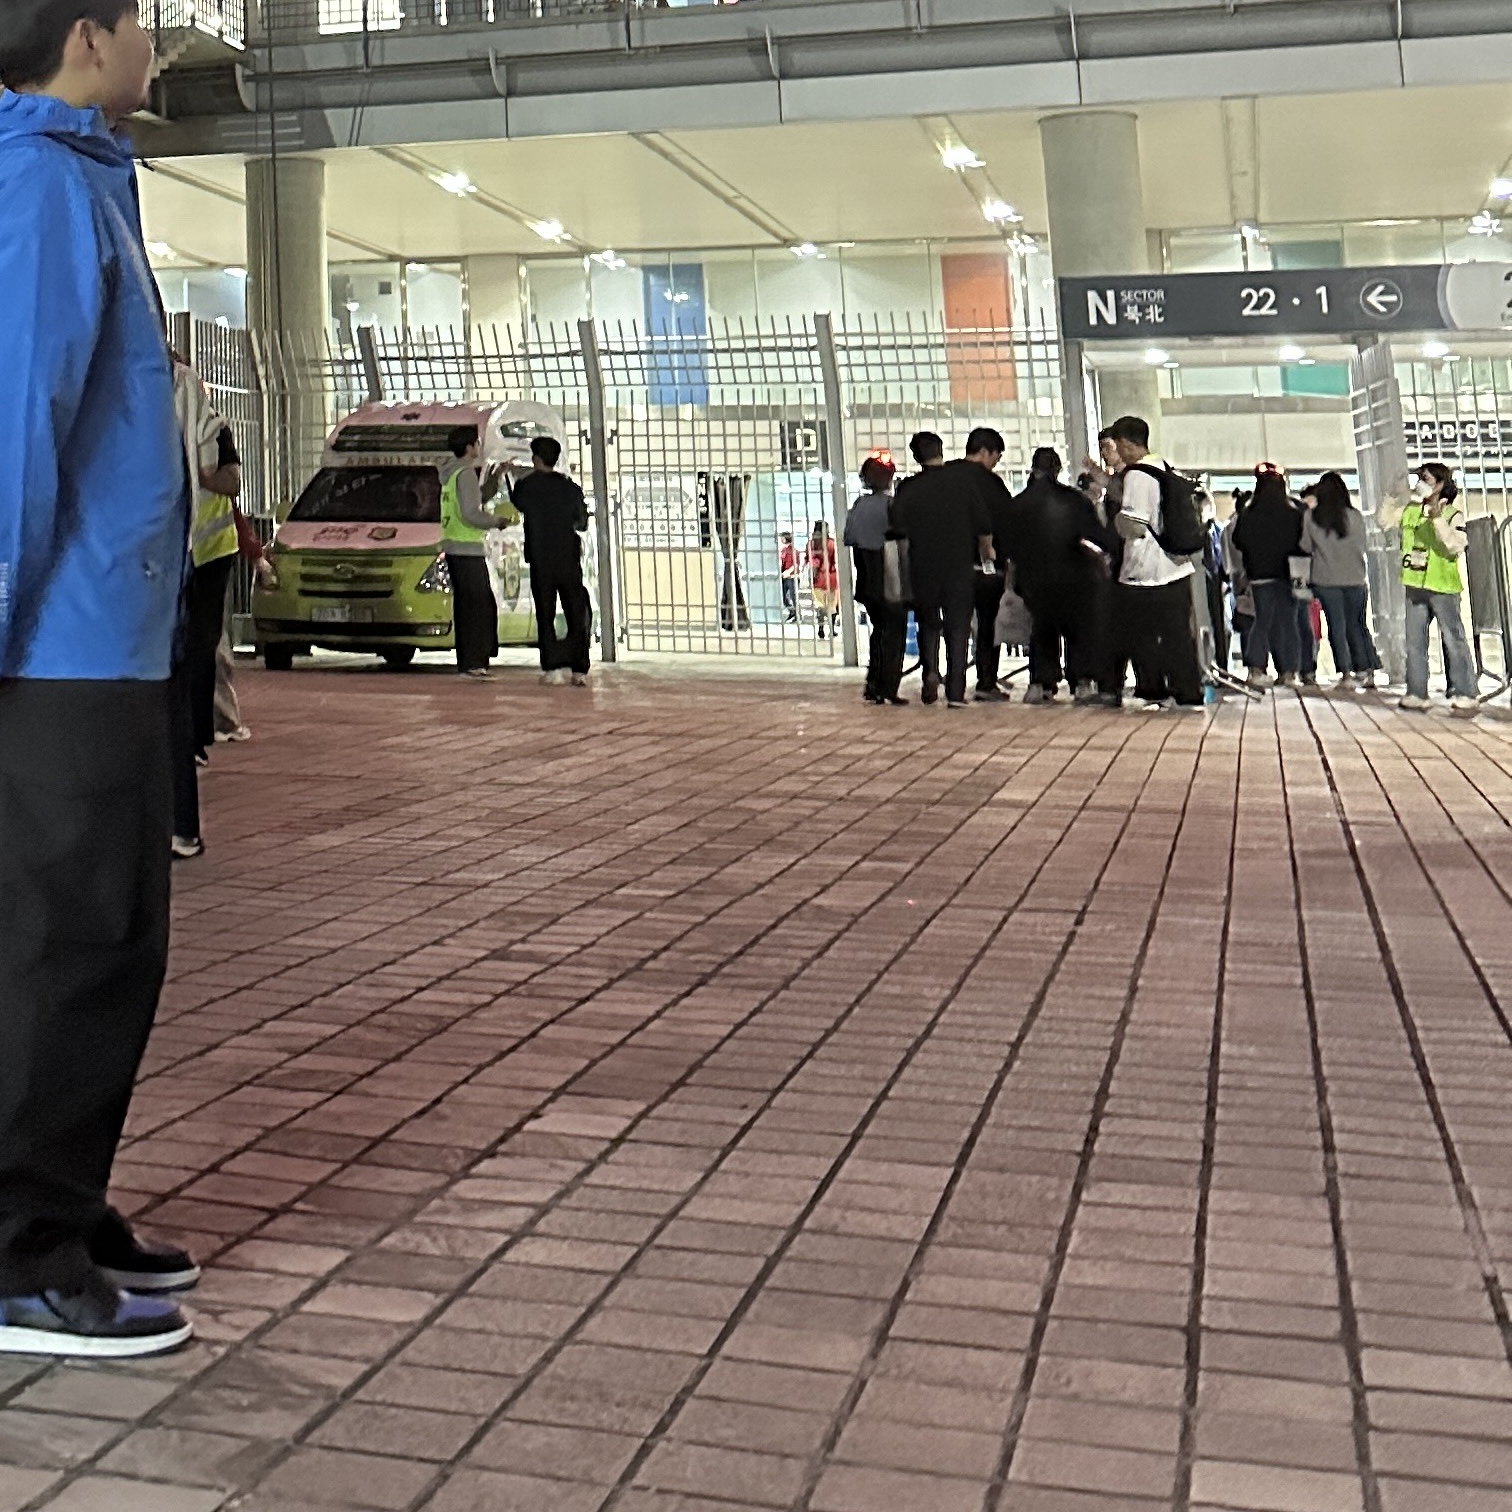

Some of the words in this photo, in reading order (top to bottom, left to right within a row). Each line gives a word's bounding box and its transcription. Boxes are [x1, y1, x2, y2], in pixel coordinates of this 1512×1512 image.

[1087, 289, 1117, 325] N
[1120, 288, 1165, 303] SECTOR
[1240, 288, 1278, 316] 22
